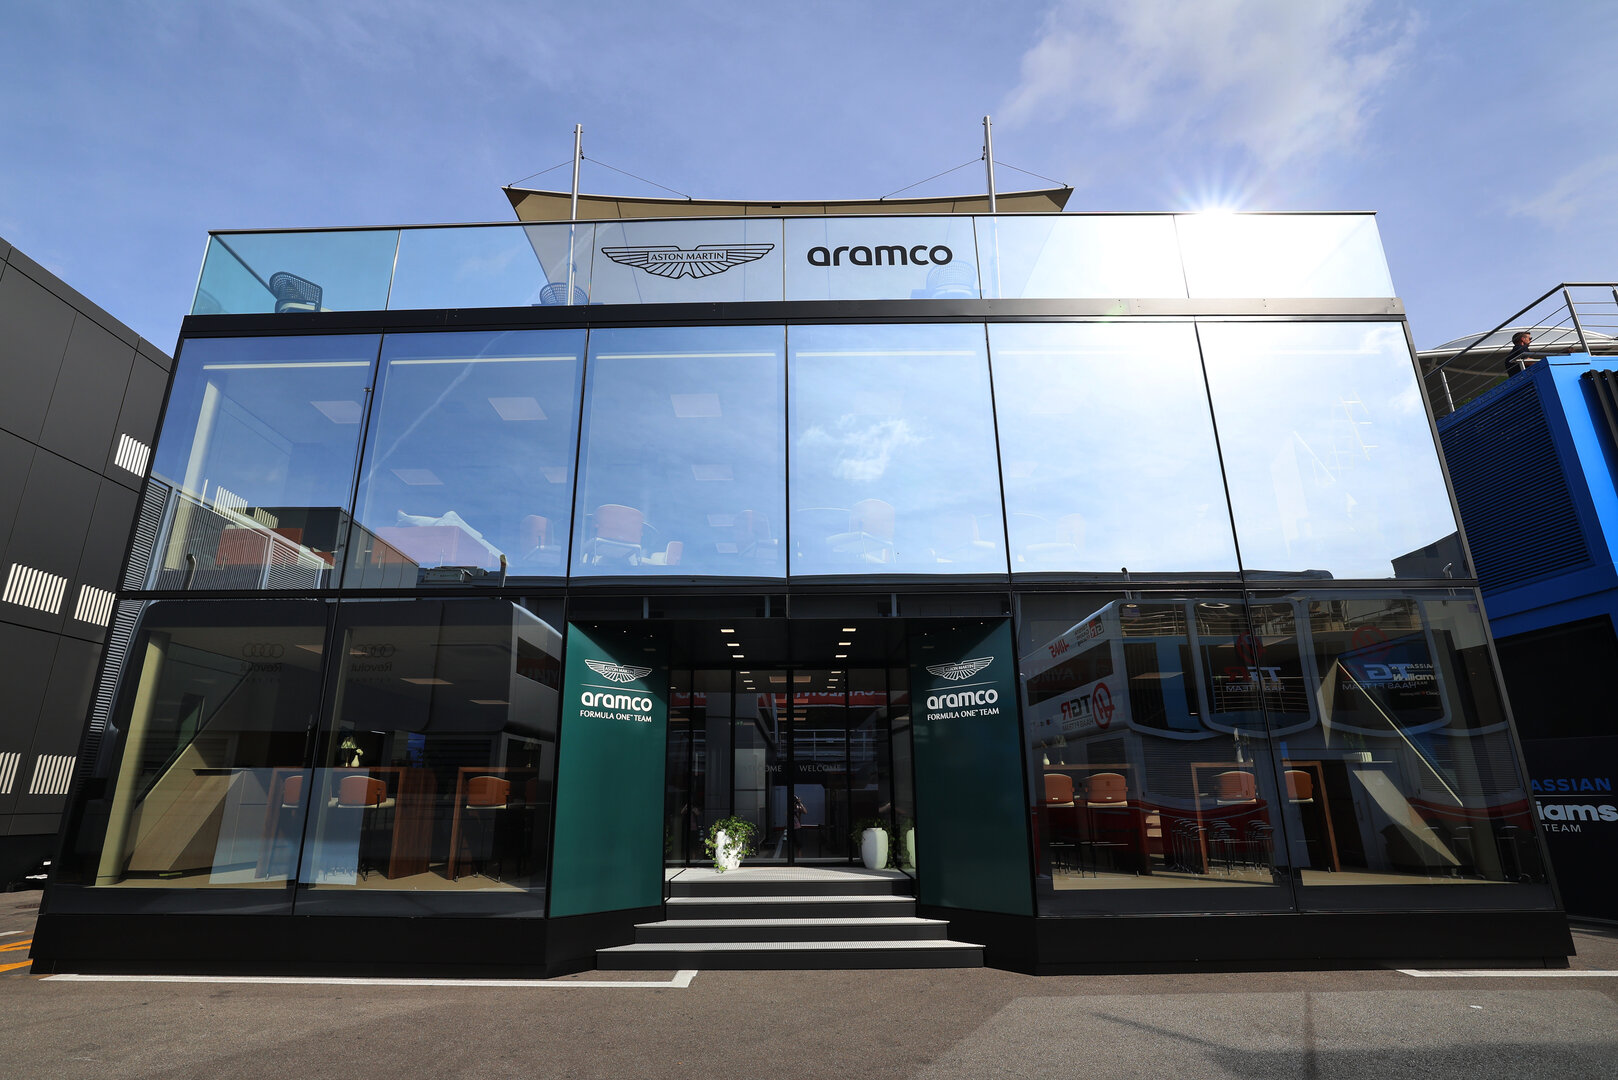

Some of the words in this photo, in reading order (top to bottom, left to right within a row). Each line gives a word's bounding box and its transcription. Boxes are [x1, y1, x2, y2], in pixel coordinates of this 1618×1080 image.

[650, 253, 684, 261] ASTON
[686, 252, 724, 260] MARTIN
[806, 244, 953, 267] aramco
[581, 691, 653, 712] aramco
[926, 689, 999, 710] aramco
[580, 709, 615, 720] FORMULA
[633, 714, 652, 723] TEAM
[927, 711, 960, 721] FORMULA
[979, 707, 1000, 717] TEAM
[1542, 823, 1582, 833] TEAM
